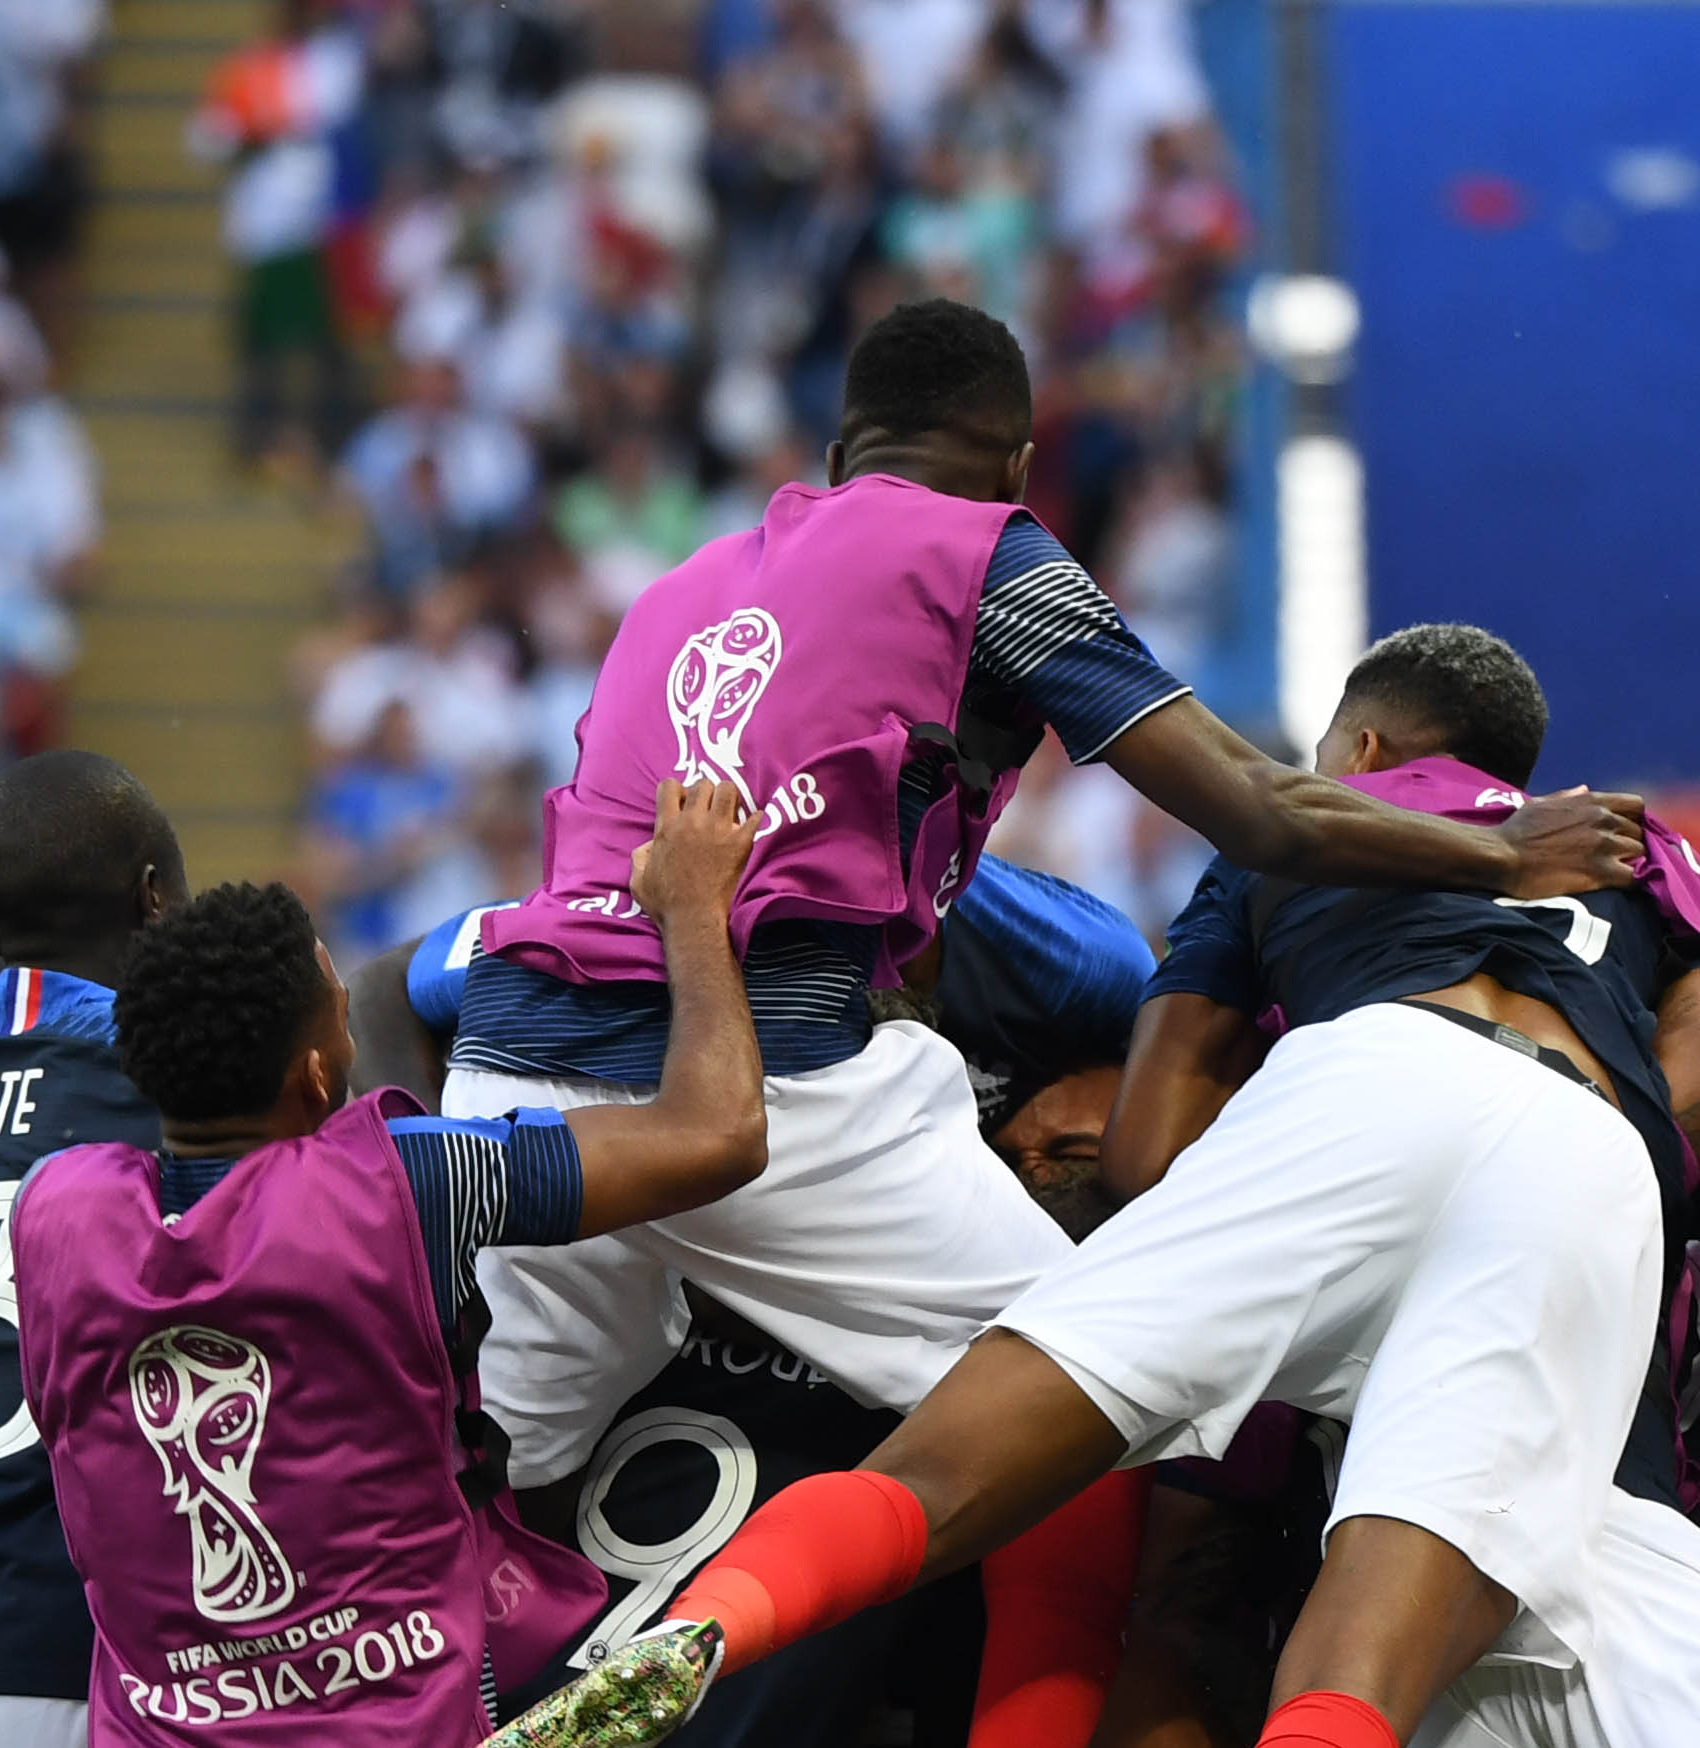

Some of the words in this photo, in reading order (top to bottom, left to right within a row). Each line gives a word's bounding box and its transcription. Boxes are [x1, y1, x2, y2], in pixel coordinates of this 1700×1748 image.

[565, 1406, 758, 1671] 9
[118, 1660, 317, 1725] RUSSIA
[316, 1610, 445, 1697] 2018
[165, 1647, 221, 1675] FIFA
[219, 1626, 309, 1662] WORLD
[308, 1607, 360, 1641] CUP
